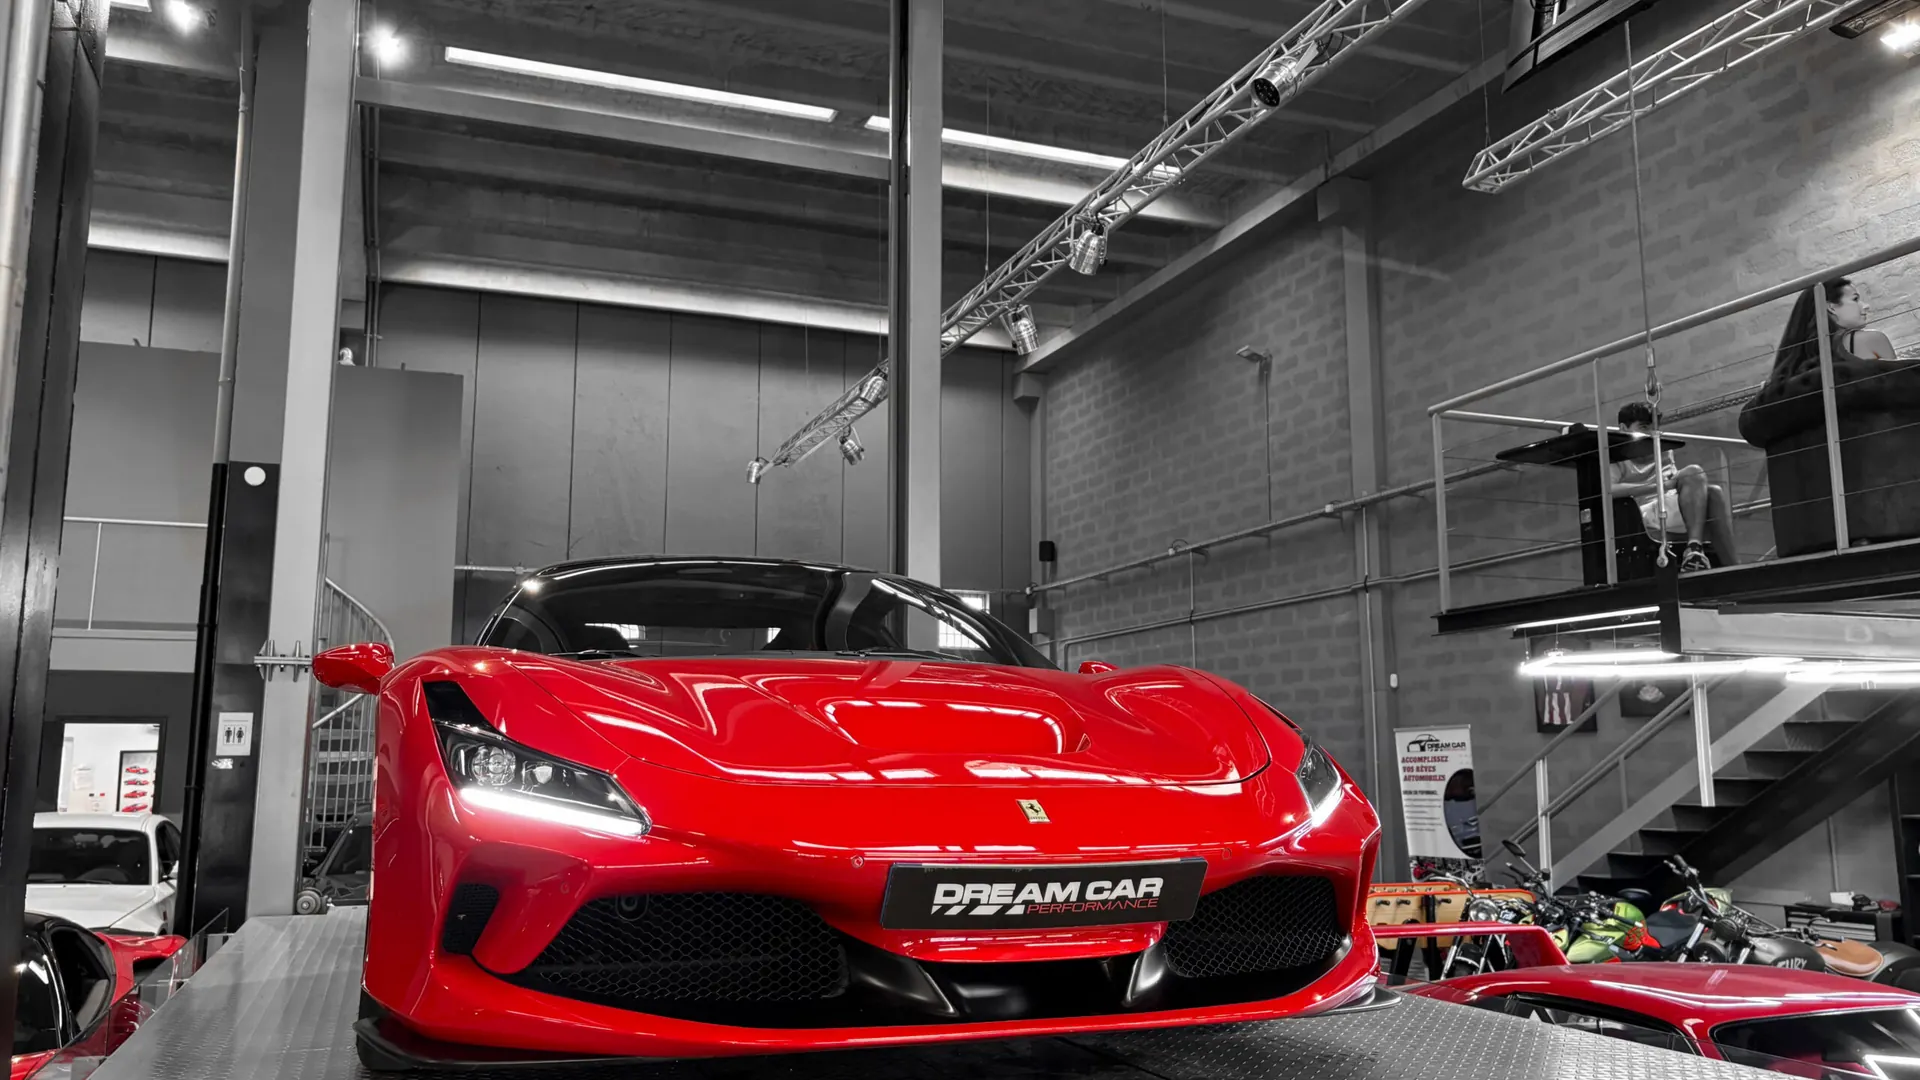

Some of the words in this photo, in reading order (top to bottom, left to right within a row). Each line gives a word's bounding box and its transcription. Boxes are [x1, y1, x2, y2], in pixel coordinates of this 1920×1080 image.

[1427, 741, 1450, 749] DREAM
[1403, 774, 1446, 782] AUTOMOBILES
[932, 881, 1082, 905] DREAM
[1085, 876, 1165, 902] CAR
[1027, 898, 1159, 914] PERFORMANCE
